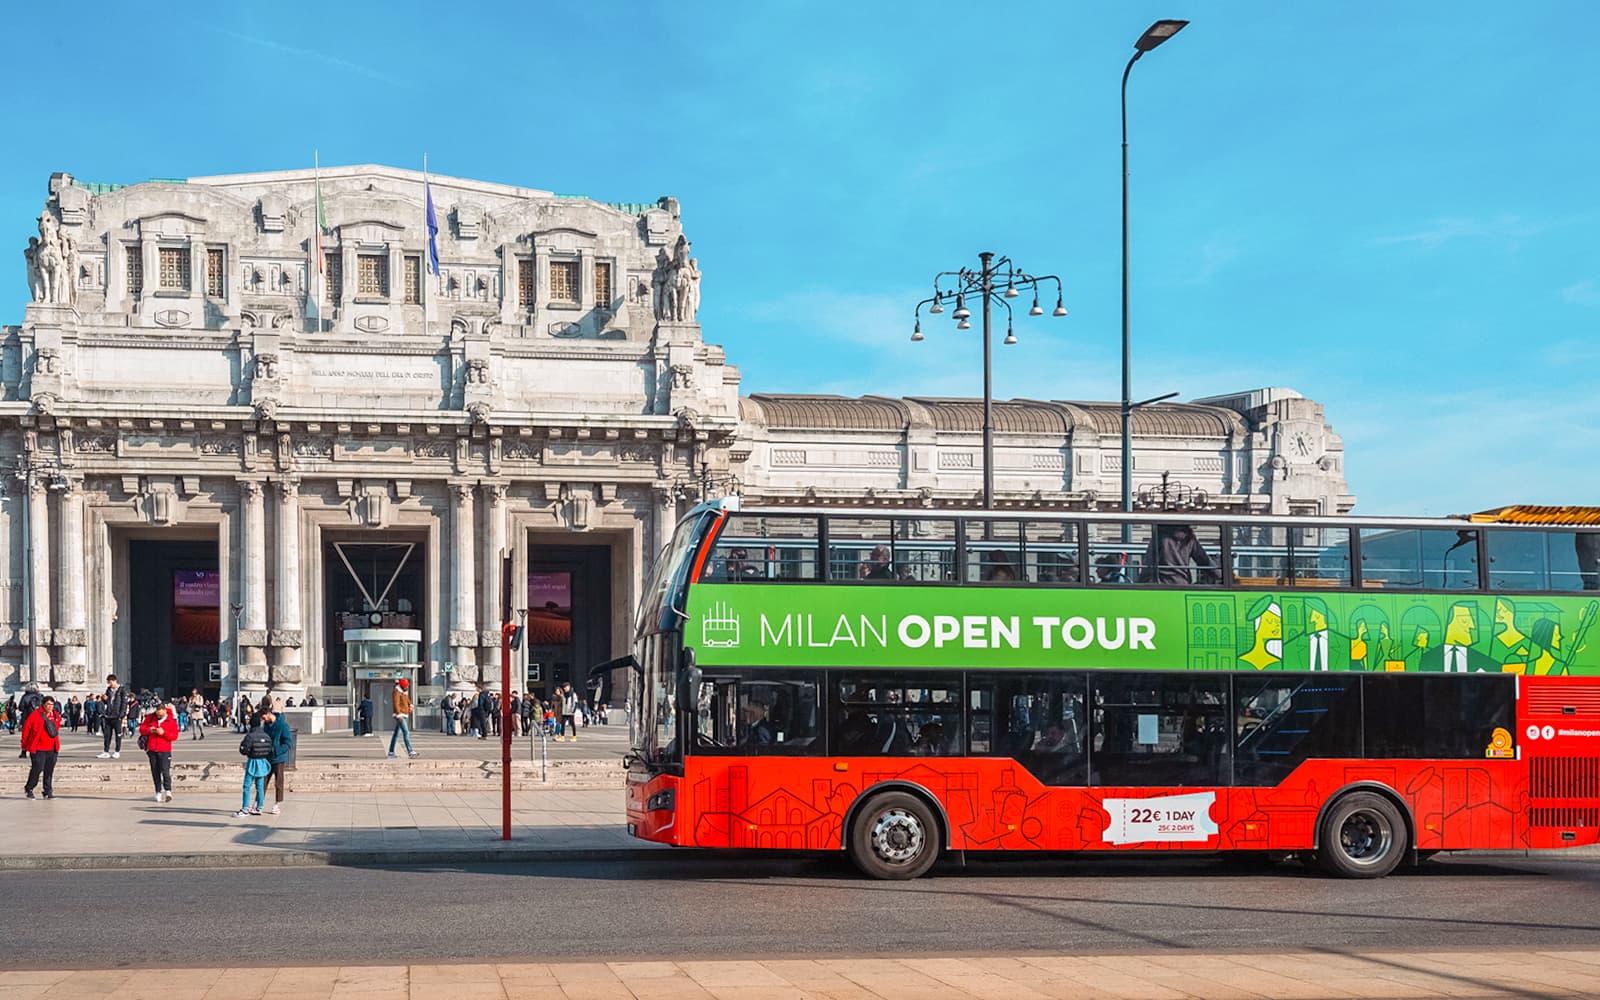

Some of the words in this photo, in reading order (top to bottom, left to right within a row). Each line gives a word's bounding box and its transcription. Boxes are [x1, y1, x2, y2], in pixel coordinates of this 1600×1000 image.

[760, 613, 888, 648] MILAN
[897, 614, 1020, 649] OPEN
[1032, 616, 1157, 650] TOUR
[1130, 808, 1161, 824] 22€
